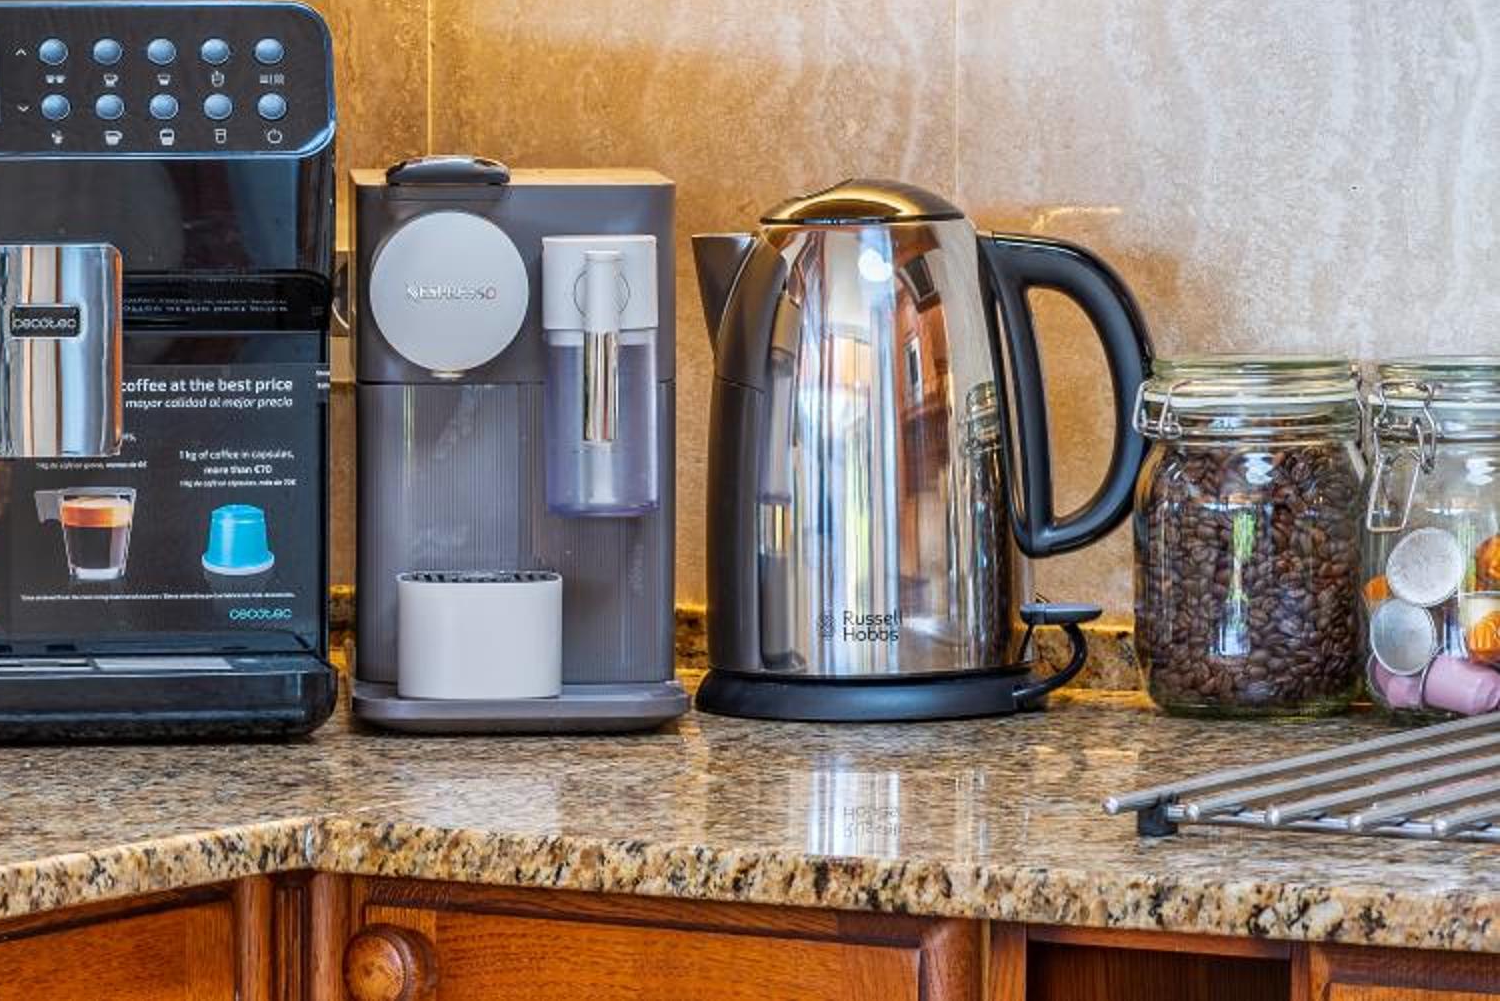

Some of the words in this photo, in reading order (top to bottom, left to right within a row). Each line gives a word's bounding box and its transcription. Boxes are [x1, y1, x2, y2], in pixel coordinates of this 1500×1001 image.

[169, 380, 186, 392] at
[189, 379, 215, 392] the
[218, 379, 251, 392] best
[255, 378, 293, 394] price
[125, 398, 162, 410] mayor
[164, 397, 207, 408] calidad
[222, 397, 257, 410] mejor
[257, 396, 293, 409] precio
[198, 450, 209, 460] of
[209, 451, 239, 460] coffee
[203, 466, 229, 474] more
[229, 465, 252, 474] than
[842, 608, 903, 626] Russell
[842, 626, 900, 642] Hobbs
